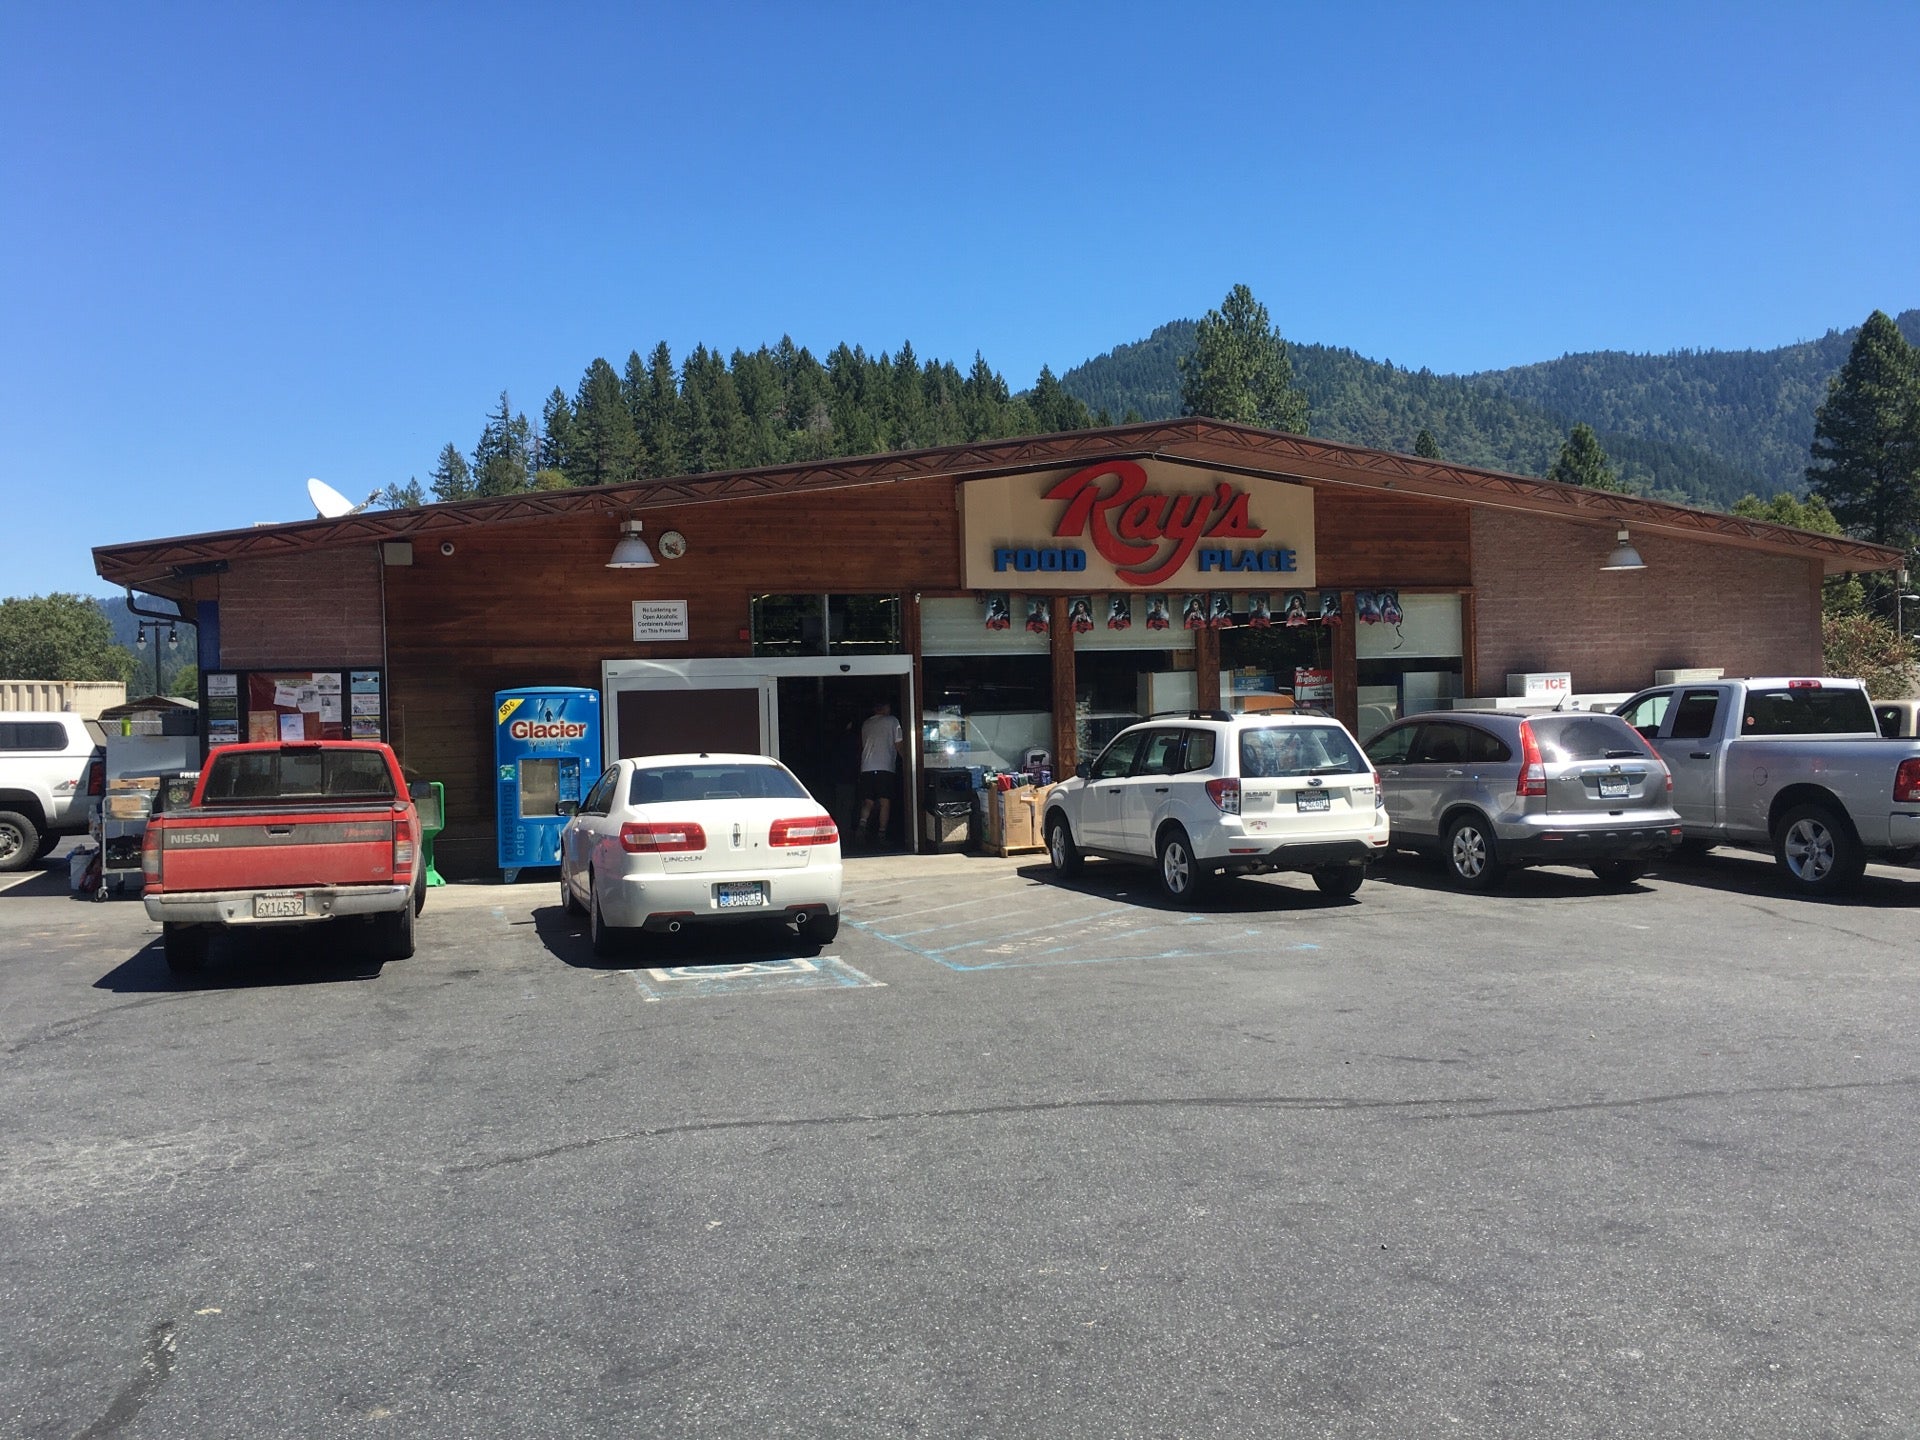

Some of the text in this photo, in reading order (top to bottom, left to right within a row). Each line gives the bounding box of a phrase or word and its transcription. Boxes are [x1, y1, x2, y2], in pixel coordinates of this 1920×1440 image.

[1041, 460, 1267, 587] Ray's
[993, 548, 1297, 572] FOOD PLACE
[1545, 678, 1567, 690] ICE
[511, 721, 587, 739] Glacier
[170, 833, 220, 844] NISSAN
[514, 825, 526, 856] crisp
[663, 855, 703, 863] LINCOLN
